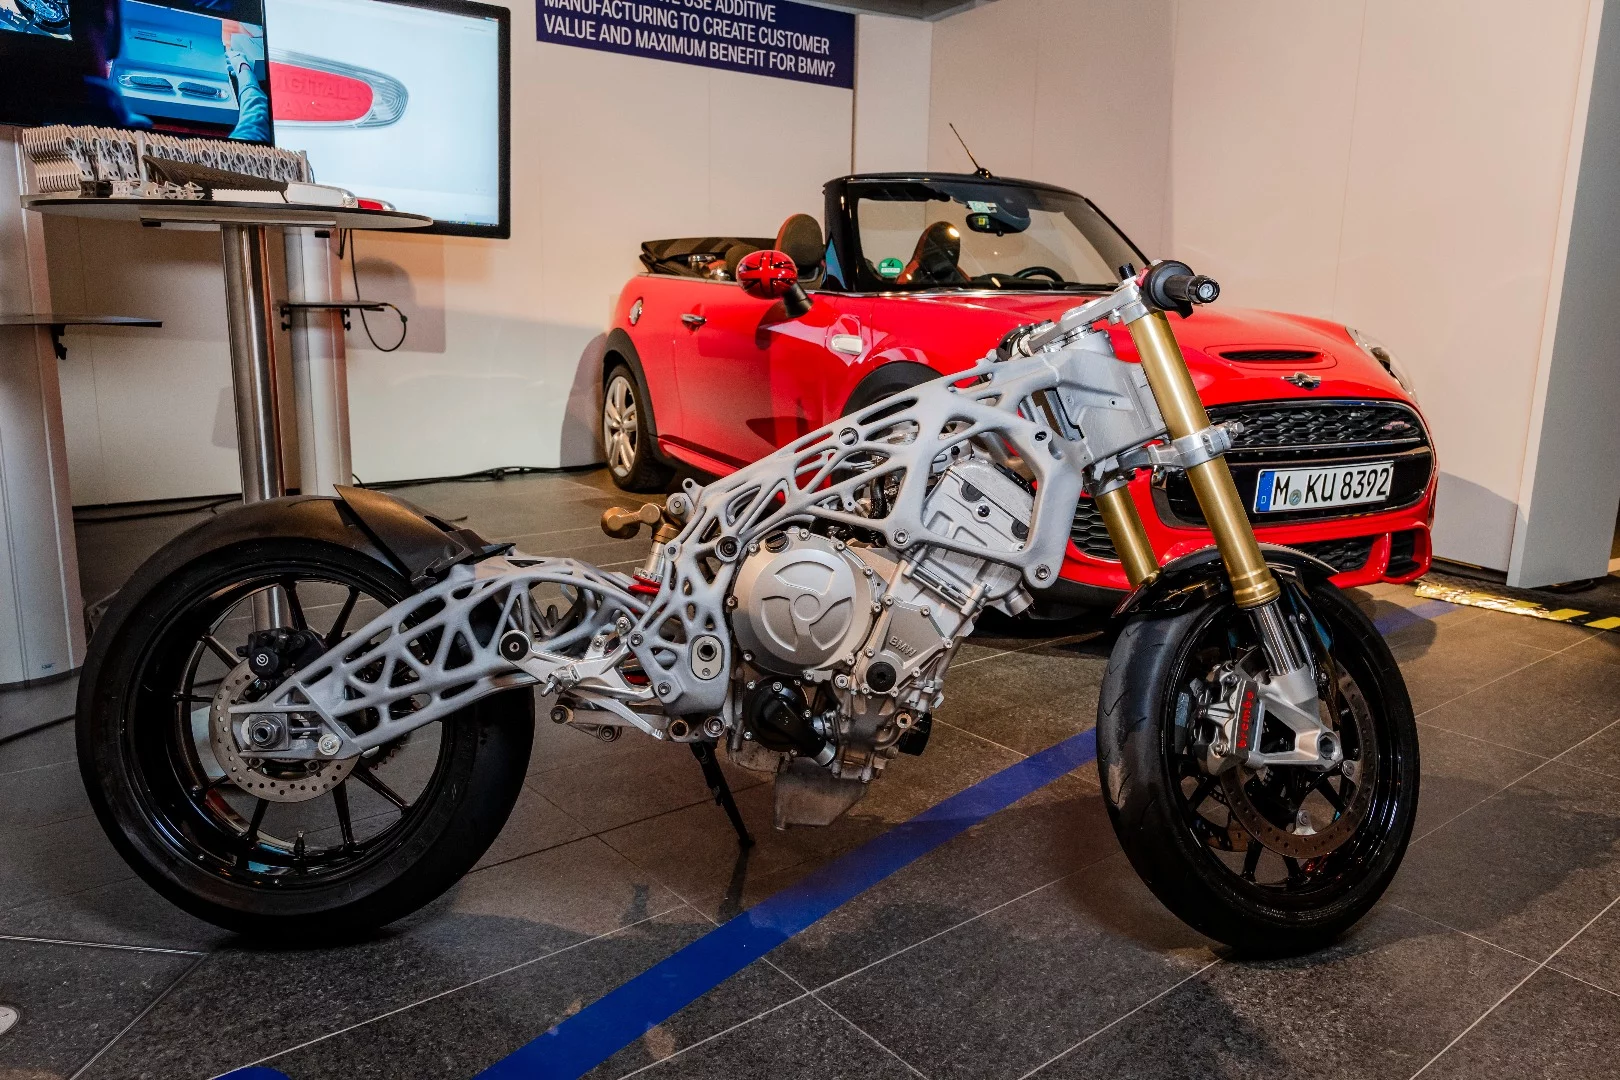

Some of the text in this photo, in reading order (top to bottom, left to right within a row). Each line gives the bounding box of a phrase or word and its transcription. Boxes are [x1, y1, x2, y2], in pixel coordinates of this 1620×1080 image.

[715, 0, 776, 22] ADDITIVE
[543, 13, 836, 78] VALUE AND MAXIMUM BENEFIT FOR BMW?
[680, 12, 700, 33] TO
[703, 16, 756, 43] CREATE
[758, 26, 830, 55] CUSTOMER
[1272, 467, 1390, 506] M KU 8392
[889, 636, 917, 657] BMW
